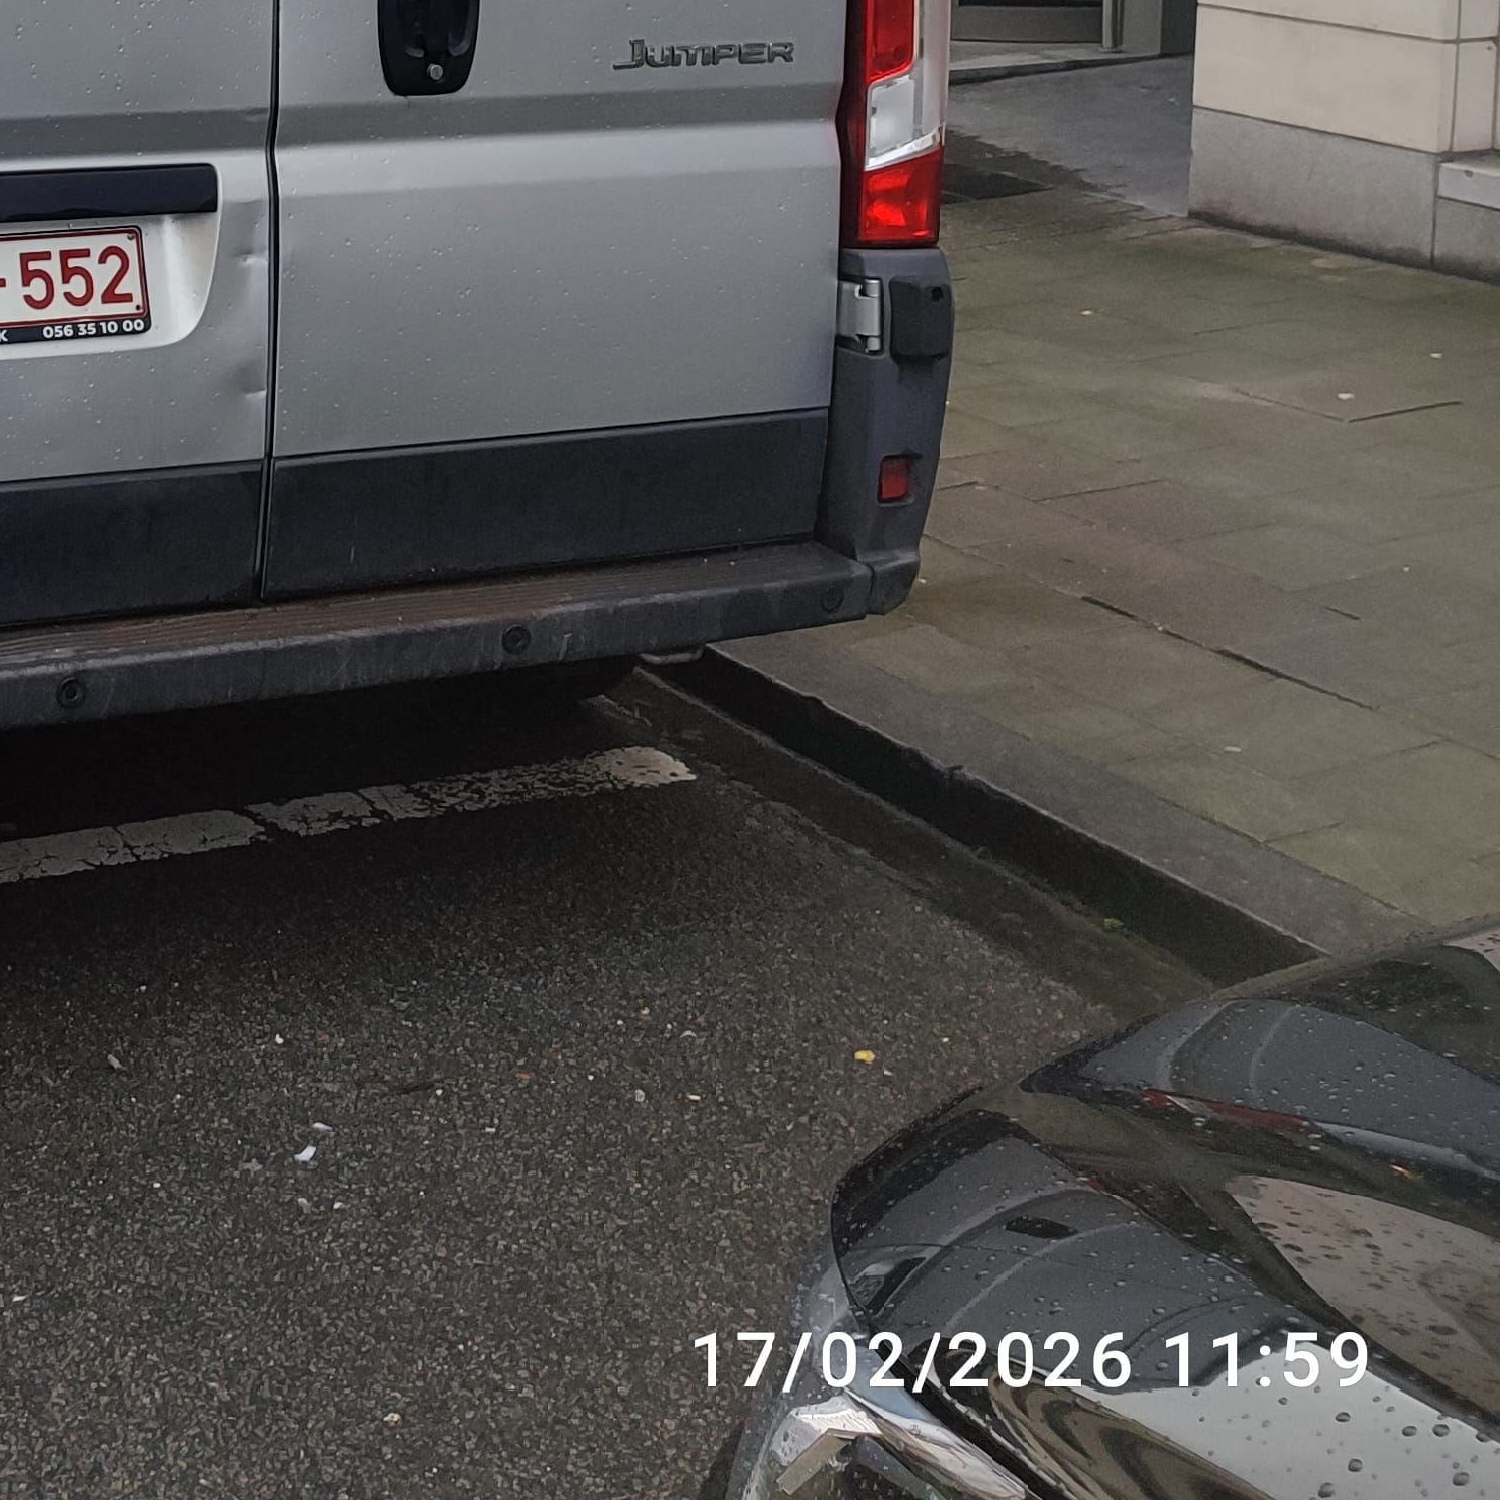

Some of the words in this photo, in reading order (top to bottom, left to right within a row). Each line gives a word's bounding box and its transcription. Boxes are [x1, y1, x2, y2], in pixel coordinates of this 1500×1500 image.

[42, 324, 74, 339] 056
[77, 322, 97, 337] 35
[100, 320, 119, 334] 10
[122, 318, 145, 332] 00
